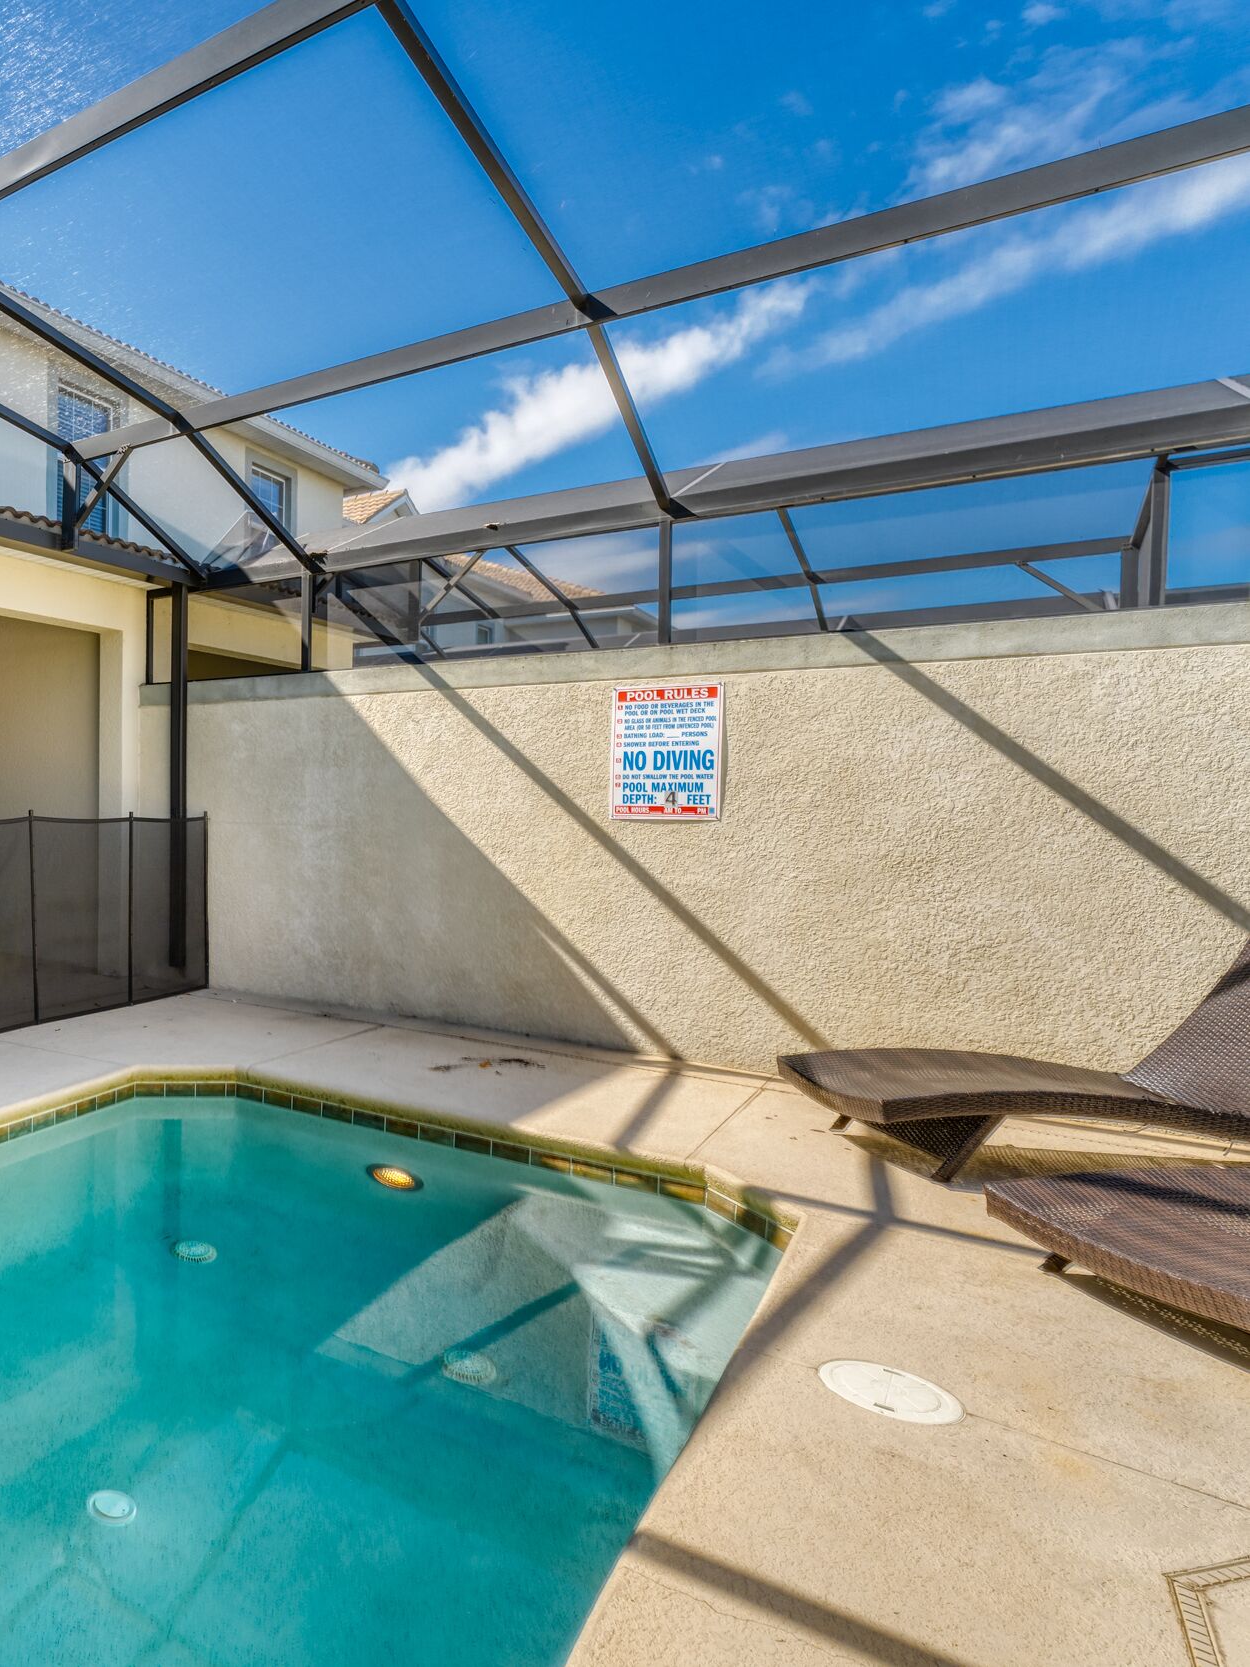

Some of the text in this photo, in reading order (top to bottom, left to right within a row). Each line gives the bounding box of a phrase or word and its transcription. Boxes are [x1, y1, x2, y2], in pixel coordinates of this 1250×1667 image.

[626, 688, 709, 701] POOL RULES
[623, 749, 714, 771] NO DIVING
[623, 782, 648, 792] POOL
[652, 782, 704, 792] MAXIMUM
[623, 791, 711, 806] DEPTH: 4 FEET
